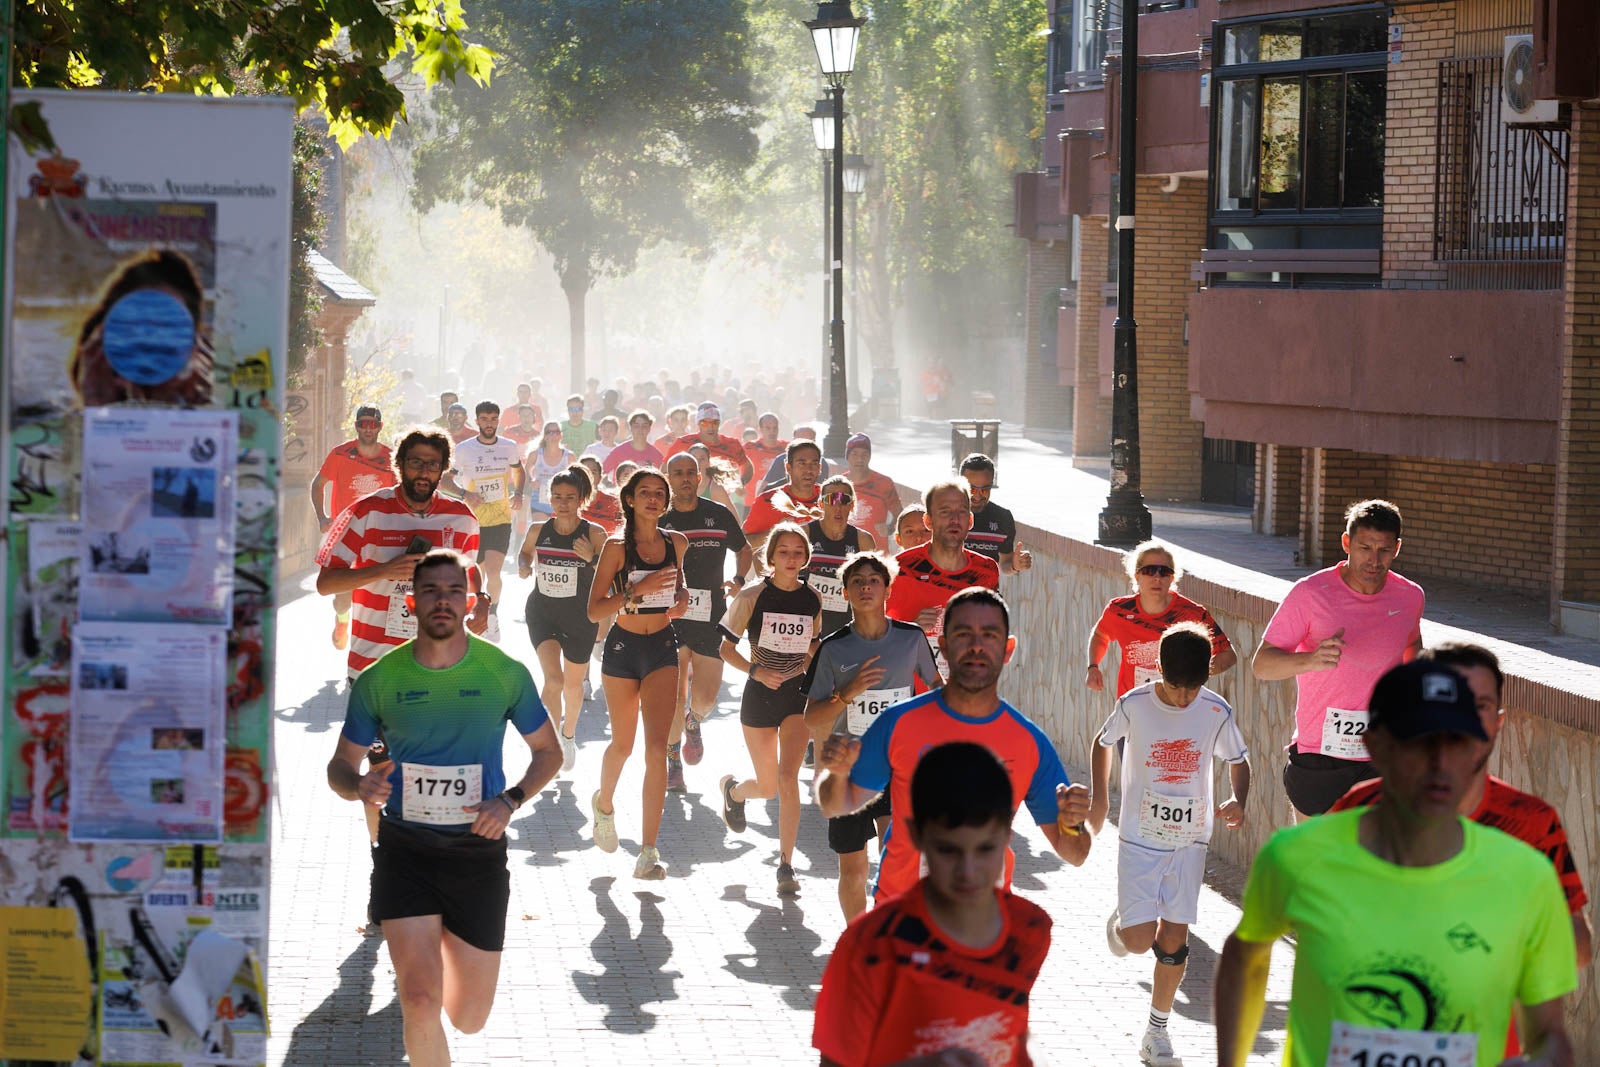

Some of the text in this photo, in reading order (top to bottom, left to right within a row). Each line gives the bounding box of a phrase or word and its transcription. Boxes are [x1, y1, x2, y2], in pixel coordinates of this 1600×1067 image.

[479, 482, 500, 492] 1753
[541, 571, 569, 584] 1360
[814, 583, 844, 597] 1014
[770, 621, 805, 636] 1039
[858, 699, 899, 715] 165
[1334, 720, 1371, 736] 122
[1151, 750, 1200, 761] carrera
[415, 777, 467, 797] 1779
[1151, 803, 1192, 823] 1301
